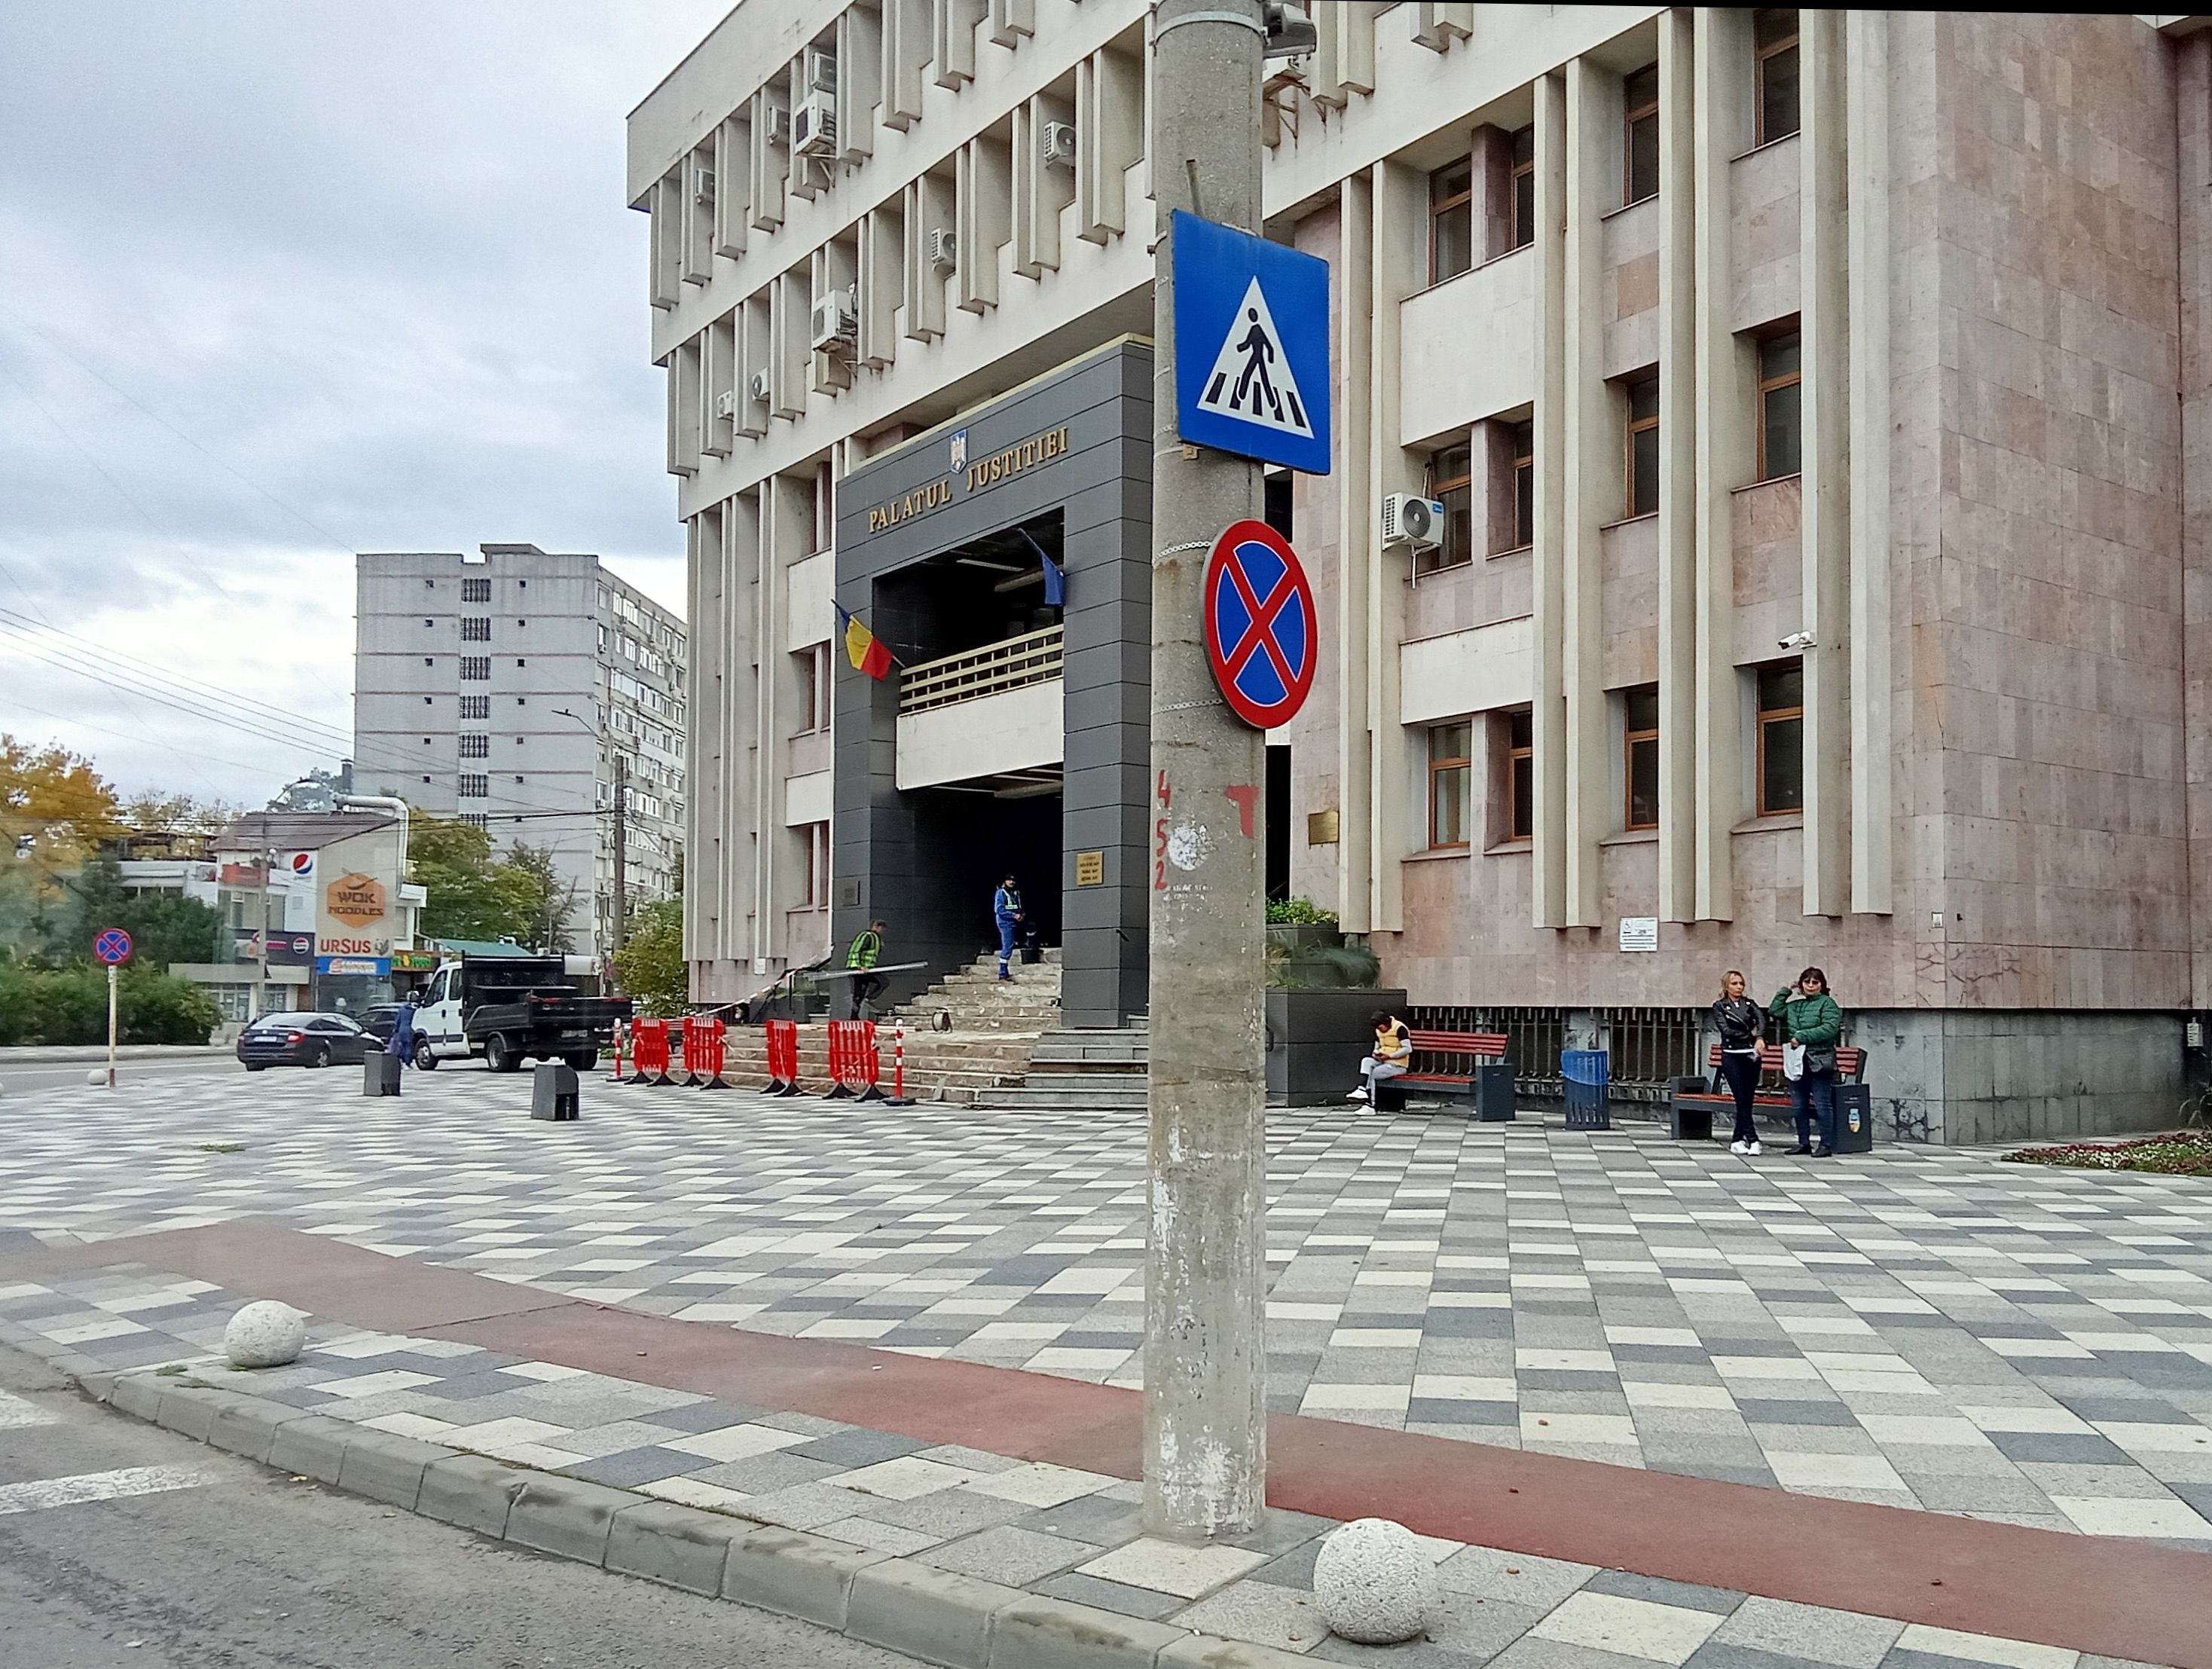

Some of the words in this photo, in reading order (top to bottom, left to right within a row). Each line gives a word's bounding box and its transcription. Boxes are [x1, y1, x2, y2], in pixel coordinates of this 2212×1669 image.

[868, 479, 952, 533] PALATUL
[966, 426, 1069, 492] JUSTITIEI
[338, 891, 376, 904] WOK
[328, 906, 385, 917] NOODLES
[320, 938, 371, 954] URSUS
